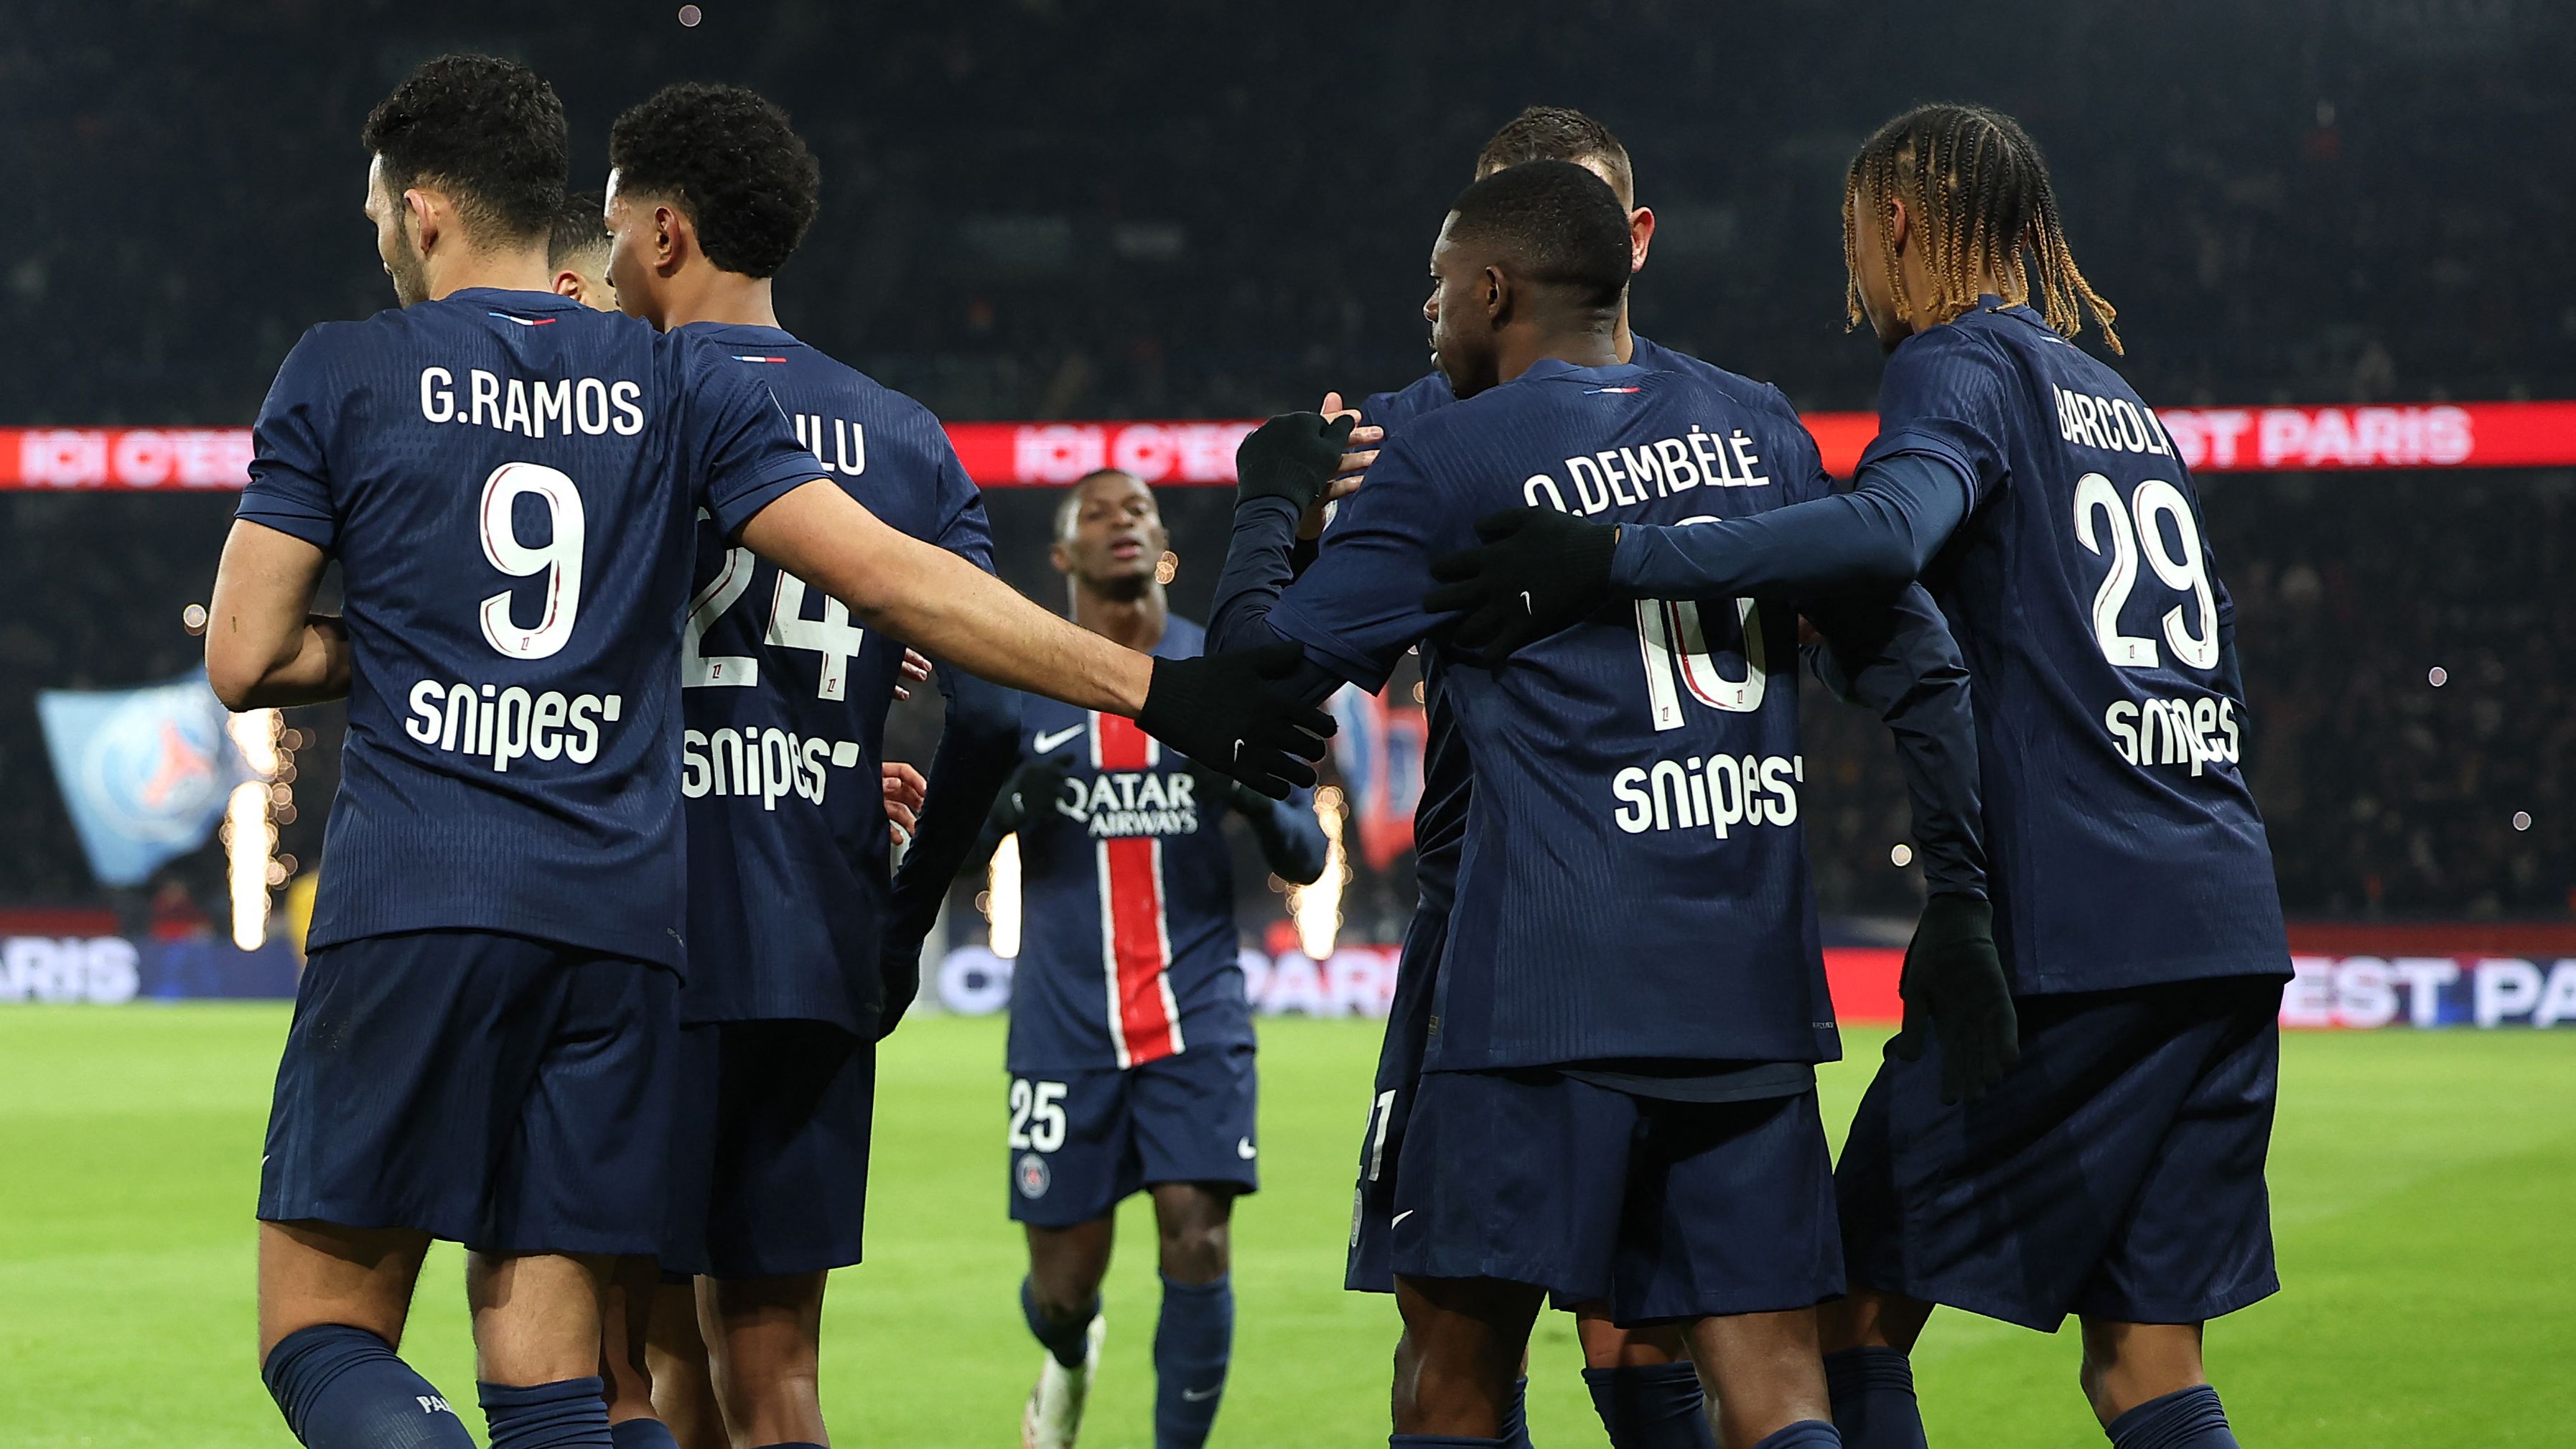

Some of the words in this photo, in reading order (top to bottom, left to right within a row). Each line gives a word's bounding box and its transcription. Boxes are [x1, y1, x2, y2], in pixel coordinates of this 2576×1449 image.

[421, 367, 644, 439] G.RAMOS
[2052, 382, 2177, 461] BARCOLA
[2259, 406, 2475, 468] PARIS
[20, 428, 108, 489] ICI
[112, 428, 253, 489] C'ES
[1013, 423, 1106, 483] ICI
[479, 461, 586, 661] 9
[2073, 472, 2220, 671] 29
[681, 506, 864, 702] 24
[1055, 773, 1196, 823] QATAR
[1088, 809, 1199, 837] AIRWAYS
[0, 936, 141, 1005] RIS
[2280, 955, 2462, 1029] EST
[2473, 956, 2576, 1030] PA
[1008, 1080, 1068, 1153] 25
[1358, 1089, 1396, 1181] 1
